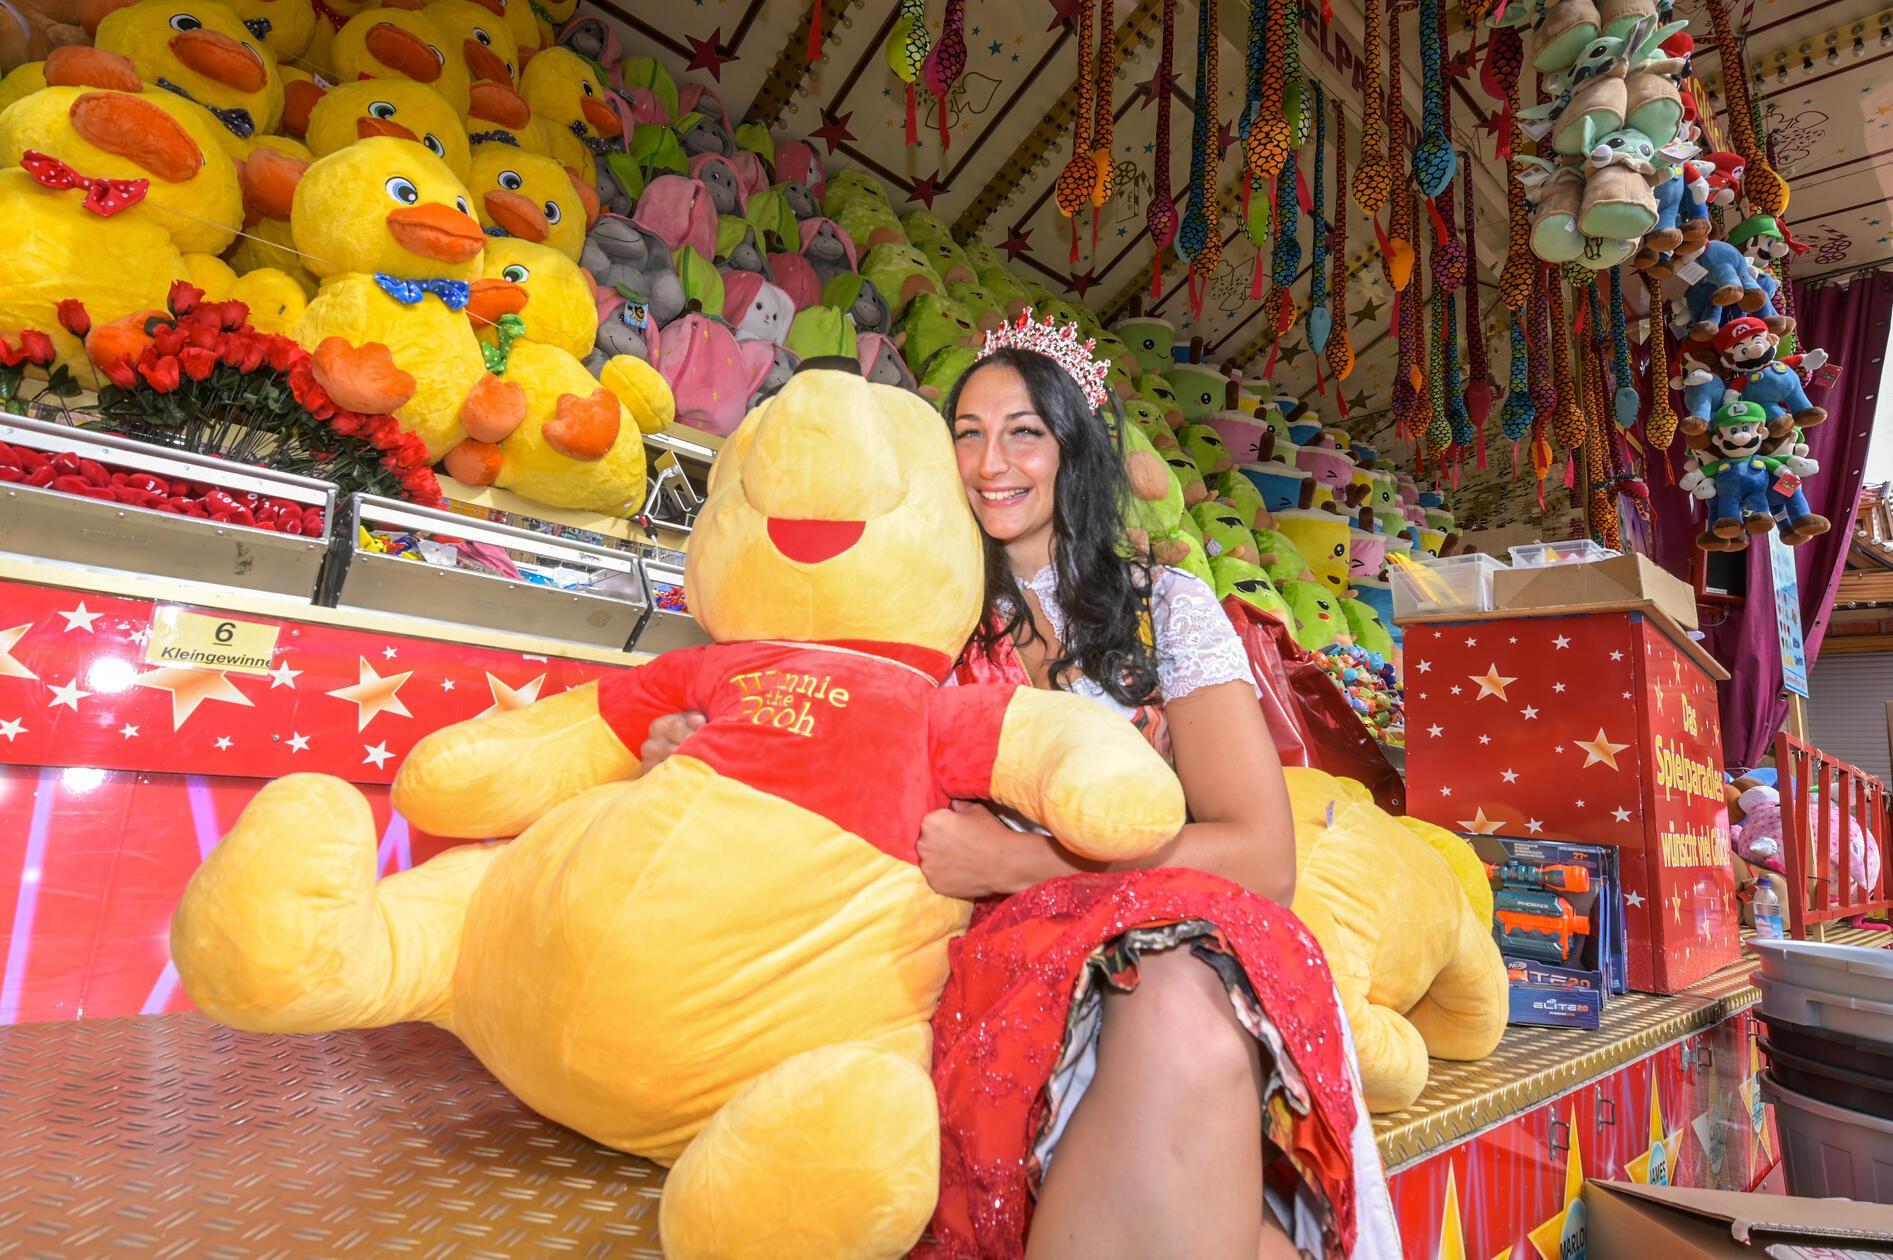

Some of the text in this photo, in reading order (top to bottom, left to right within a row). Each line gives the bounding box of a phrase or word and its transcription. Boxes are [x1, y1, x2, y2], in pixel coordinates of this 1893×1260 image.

[1736, 326, 1748, 335] M
[215, 622, 236, 643] 6
[765, 690, 794, 707] the
[1681, 693, 1698, 738] Das
[1655, 734, 1725, 807] Spielparadies
[1660, 820, 1699, 868] wünscht
[1698, 824, 1712, 867] viel
[1517, 901, 1549, 909] PHOENIX
[1532, 1001, 1577, 1012] ELITE
[1648, 1160, 1666, 1184] JAMES
[1560, 1224, 1588, 1260] MARLO
